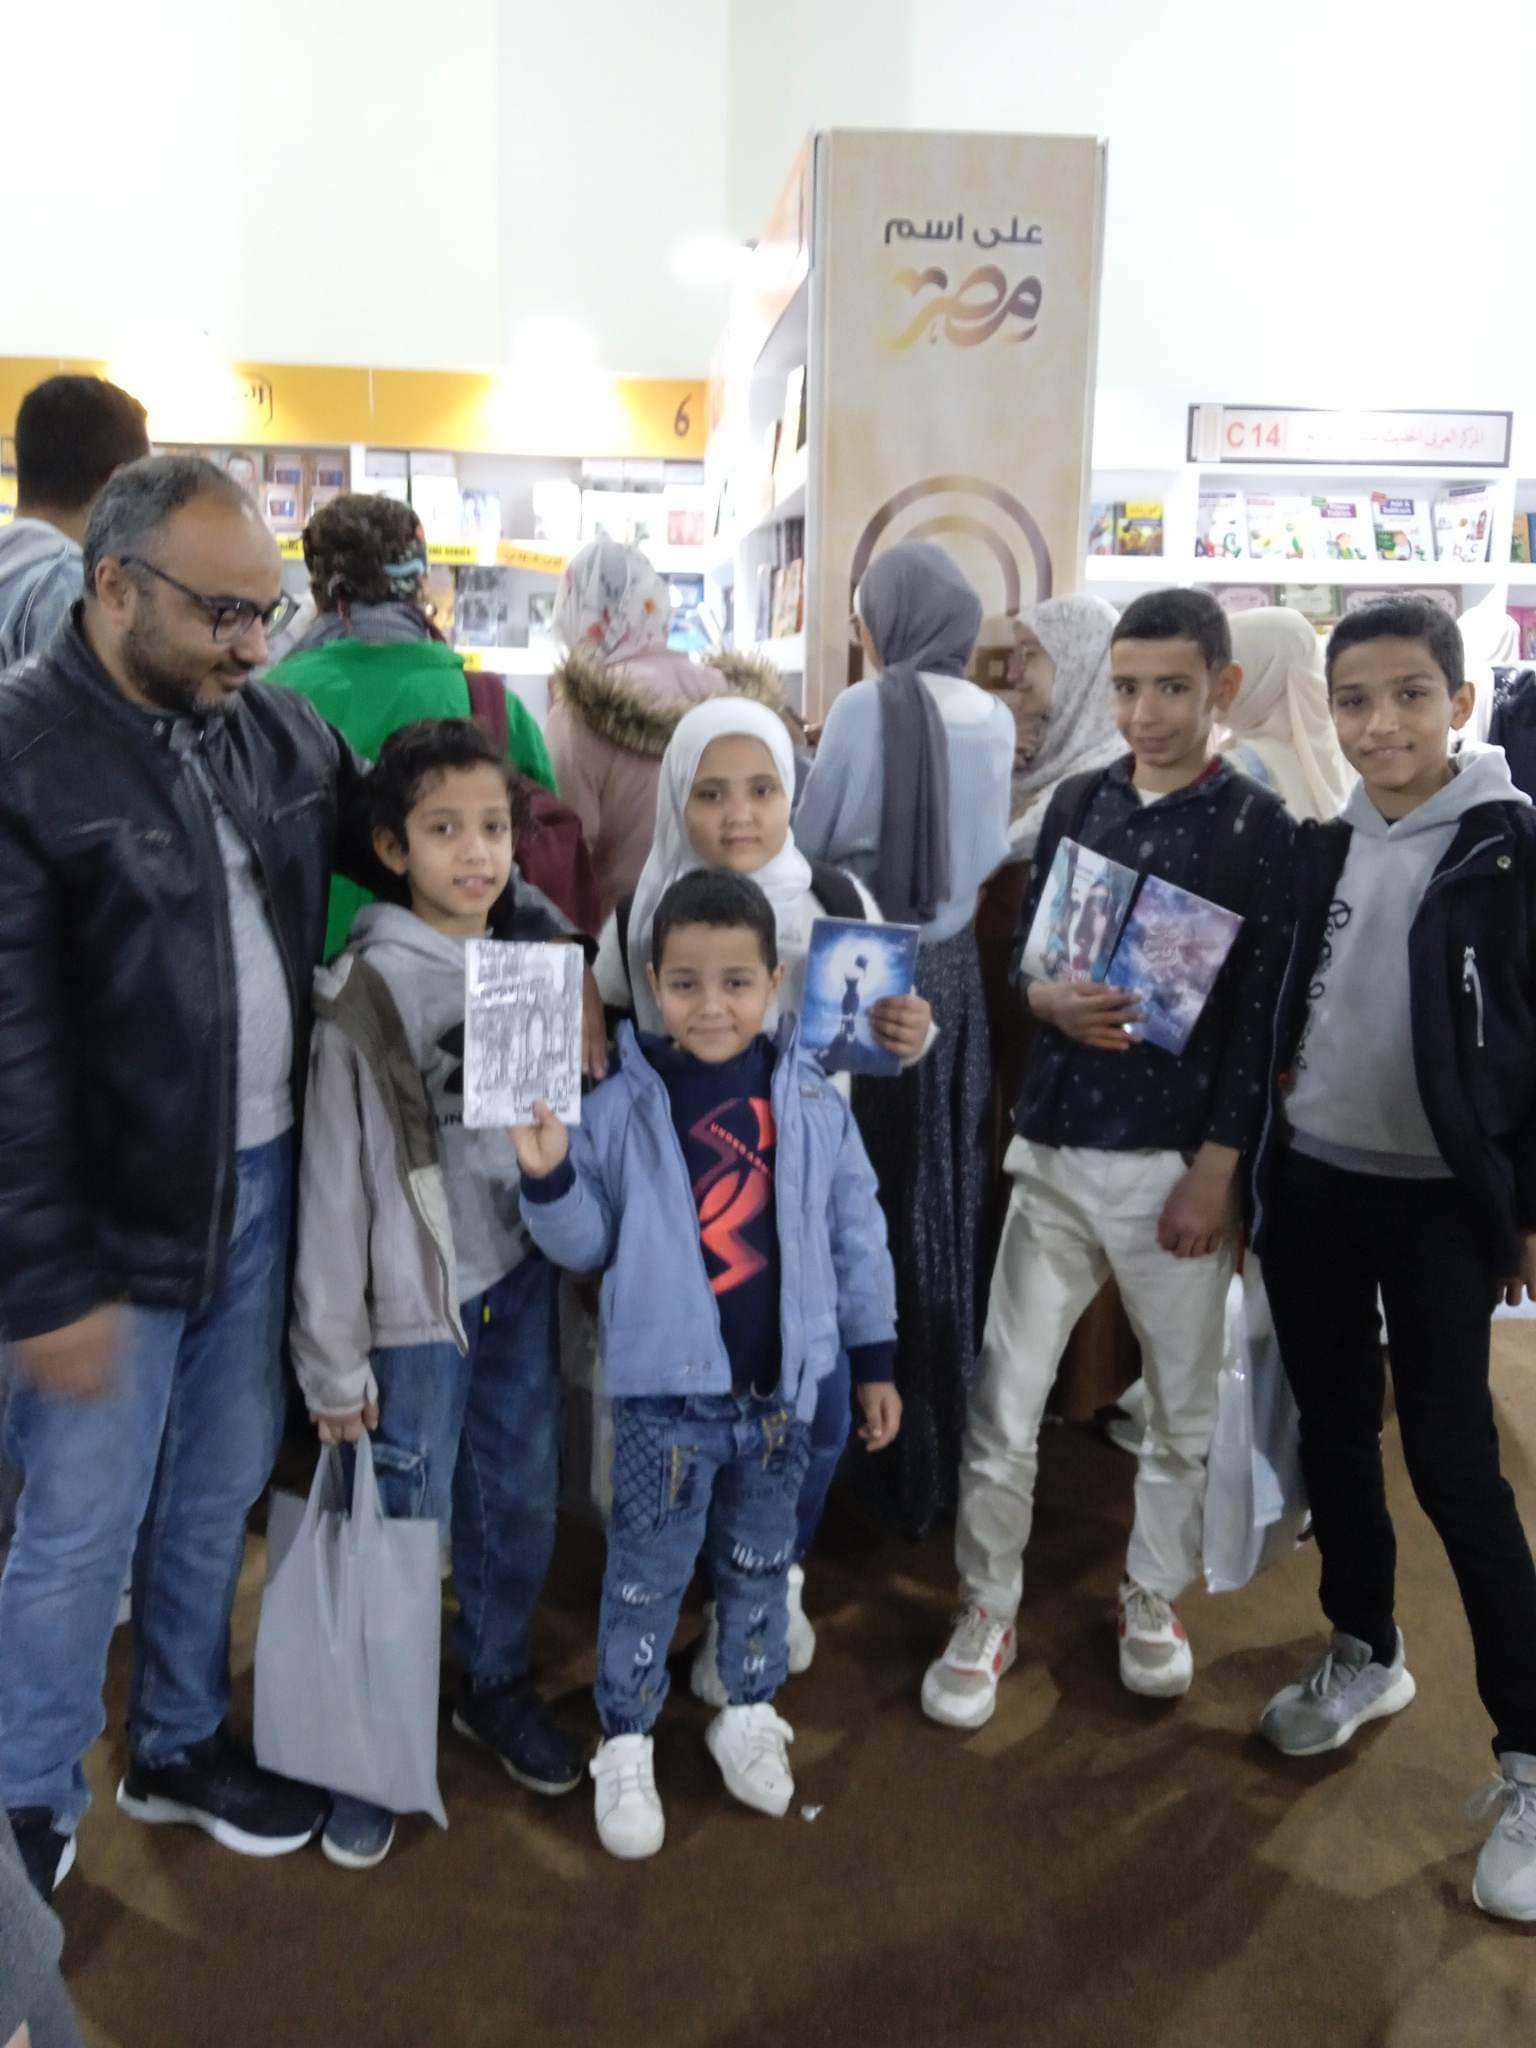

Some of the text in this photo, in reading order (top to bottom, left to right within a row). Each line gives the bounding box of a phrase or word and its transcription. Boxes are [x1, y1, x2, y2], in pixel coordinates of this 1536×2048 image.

[884, 213, 1043, 249] على اسم
[884, 264, 1042, 353] مصر
[673, 393, 694, 438] 6
